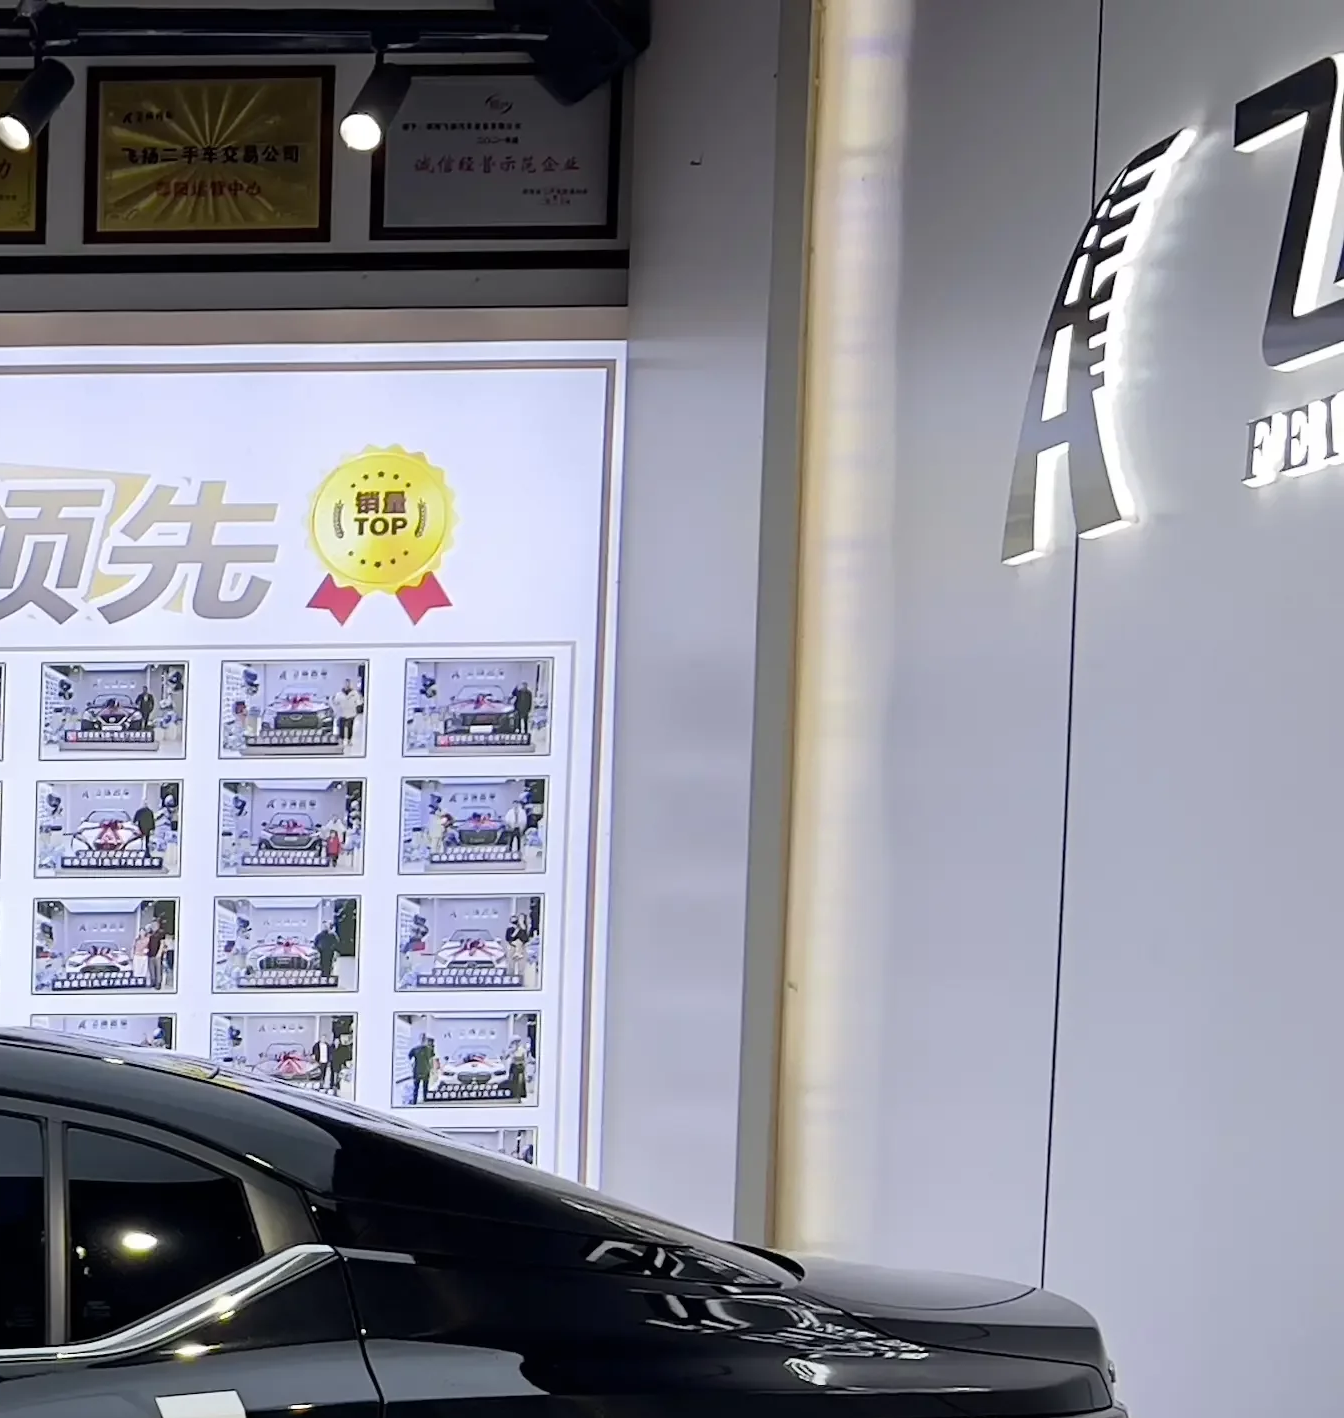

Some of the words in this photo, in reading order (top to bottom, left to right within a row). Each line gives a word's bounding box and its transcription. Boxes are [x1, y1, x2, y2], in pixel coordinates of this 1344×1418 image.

[122, 145, 299, 164] 飞扬二手车交易公司
[355, 490, 407, 514] 销量
[354, 517, 408, 536] TOP
